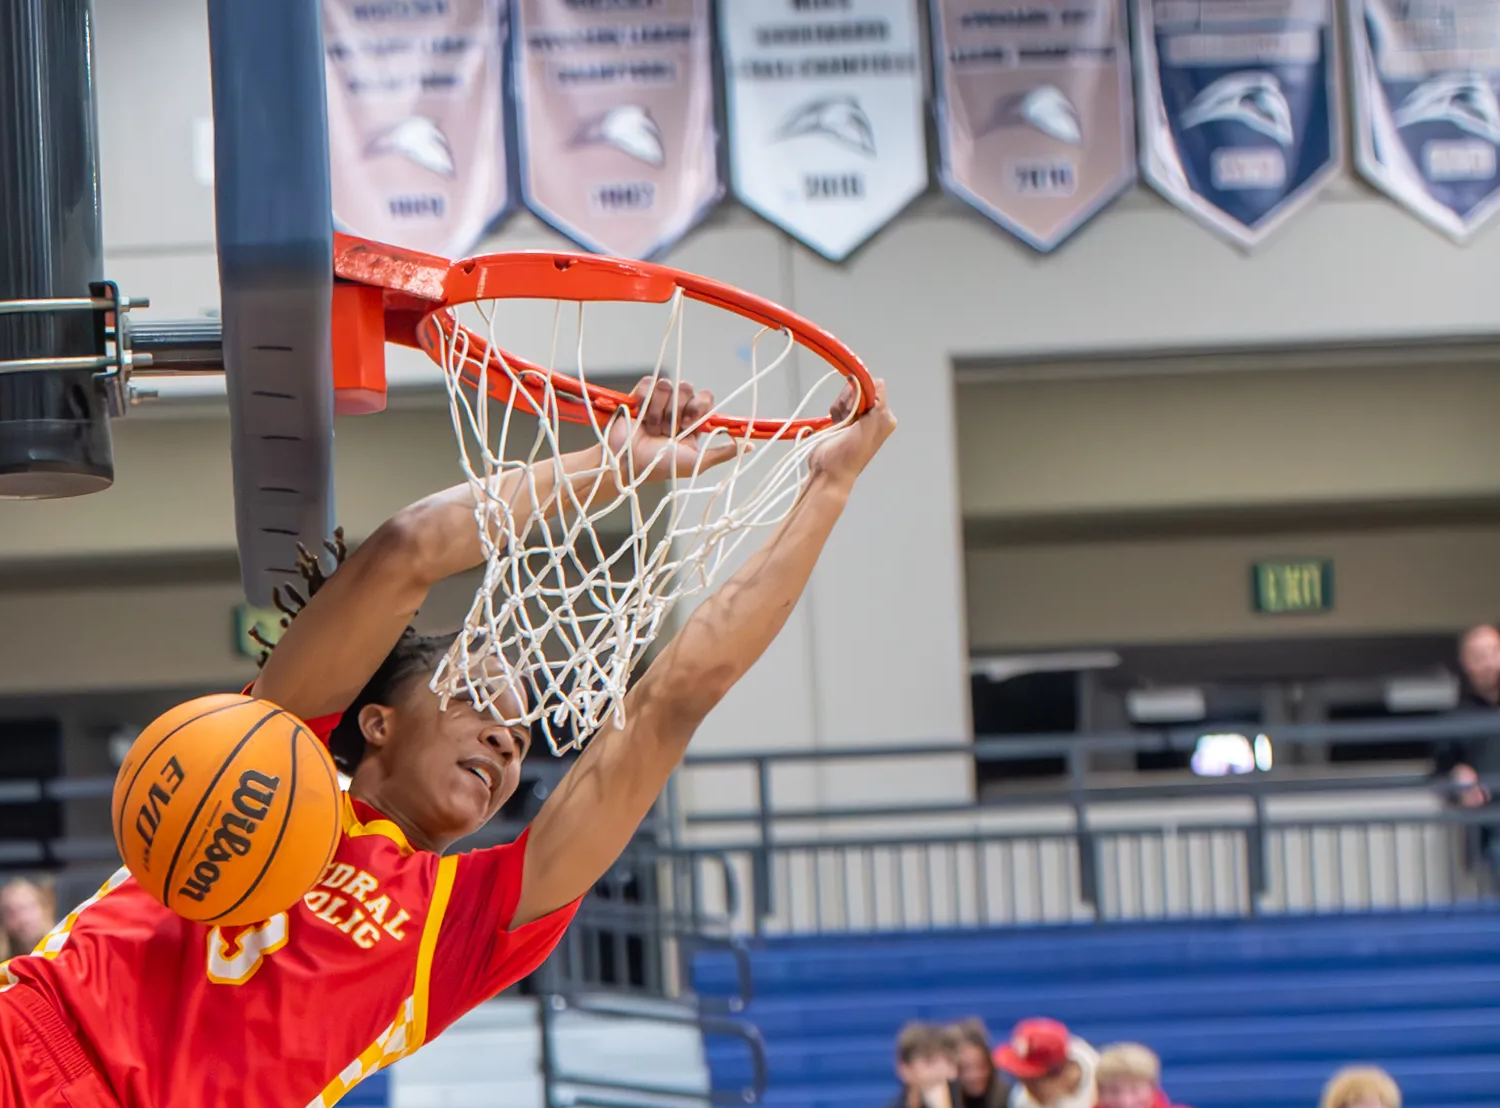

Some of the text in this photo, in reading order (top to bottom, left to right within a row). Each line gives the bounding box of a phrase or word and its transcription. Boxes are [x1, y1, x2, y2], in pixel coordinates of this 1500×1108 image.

[136, 755, 185, 848] EVO
[177, 769, 281, 902] Wilson
[313, 861, 411, 942] DRAL
